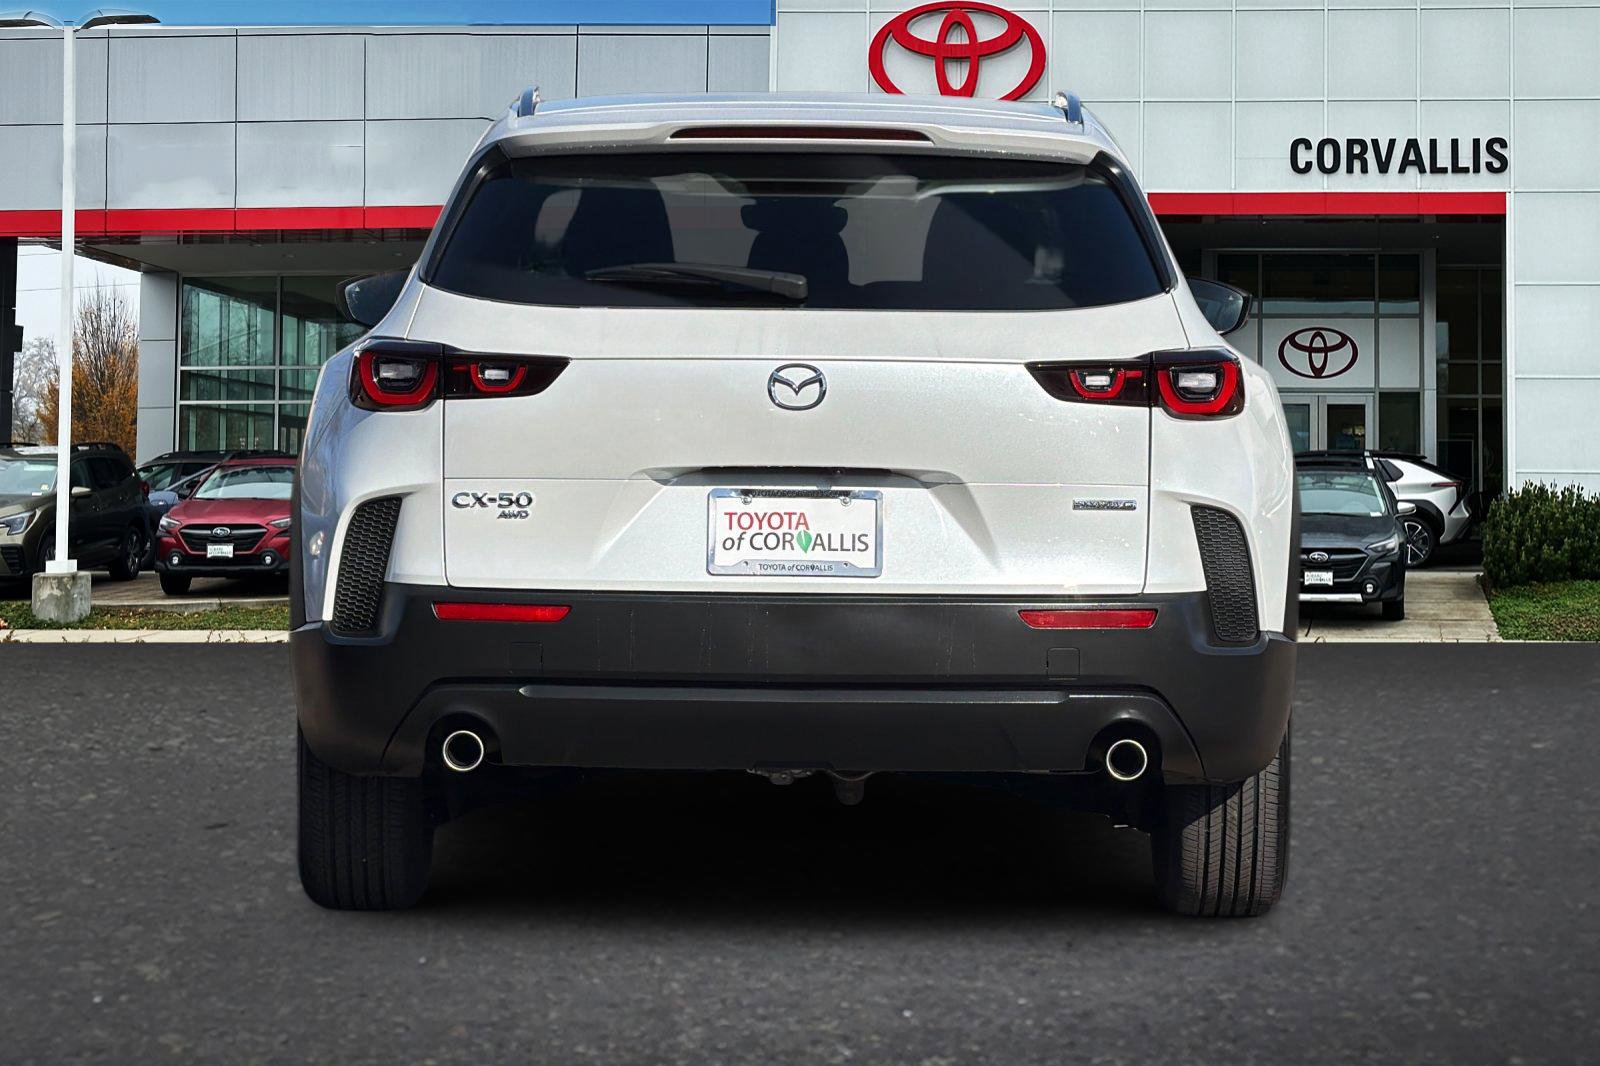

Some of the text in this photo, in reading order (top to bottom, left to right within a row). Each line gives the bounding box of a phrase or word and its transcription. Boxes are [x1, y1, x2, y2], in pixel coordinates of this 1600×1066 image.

[1290, 137, 1509, 174] CORVALLIS
[452, 492, 533, 508] CX-50
[497, 510, 529, 519] AWD
[724, 511, 809, 531] TOYOTA
[722, 532, 746, 551] of
